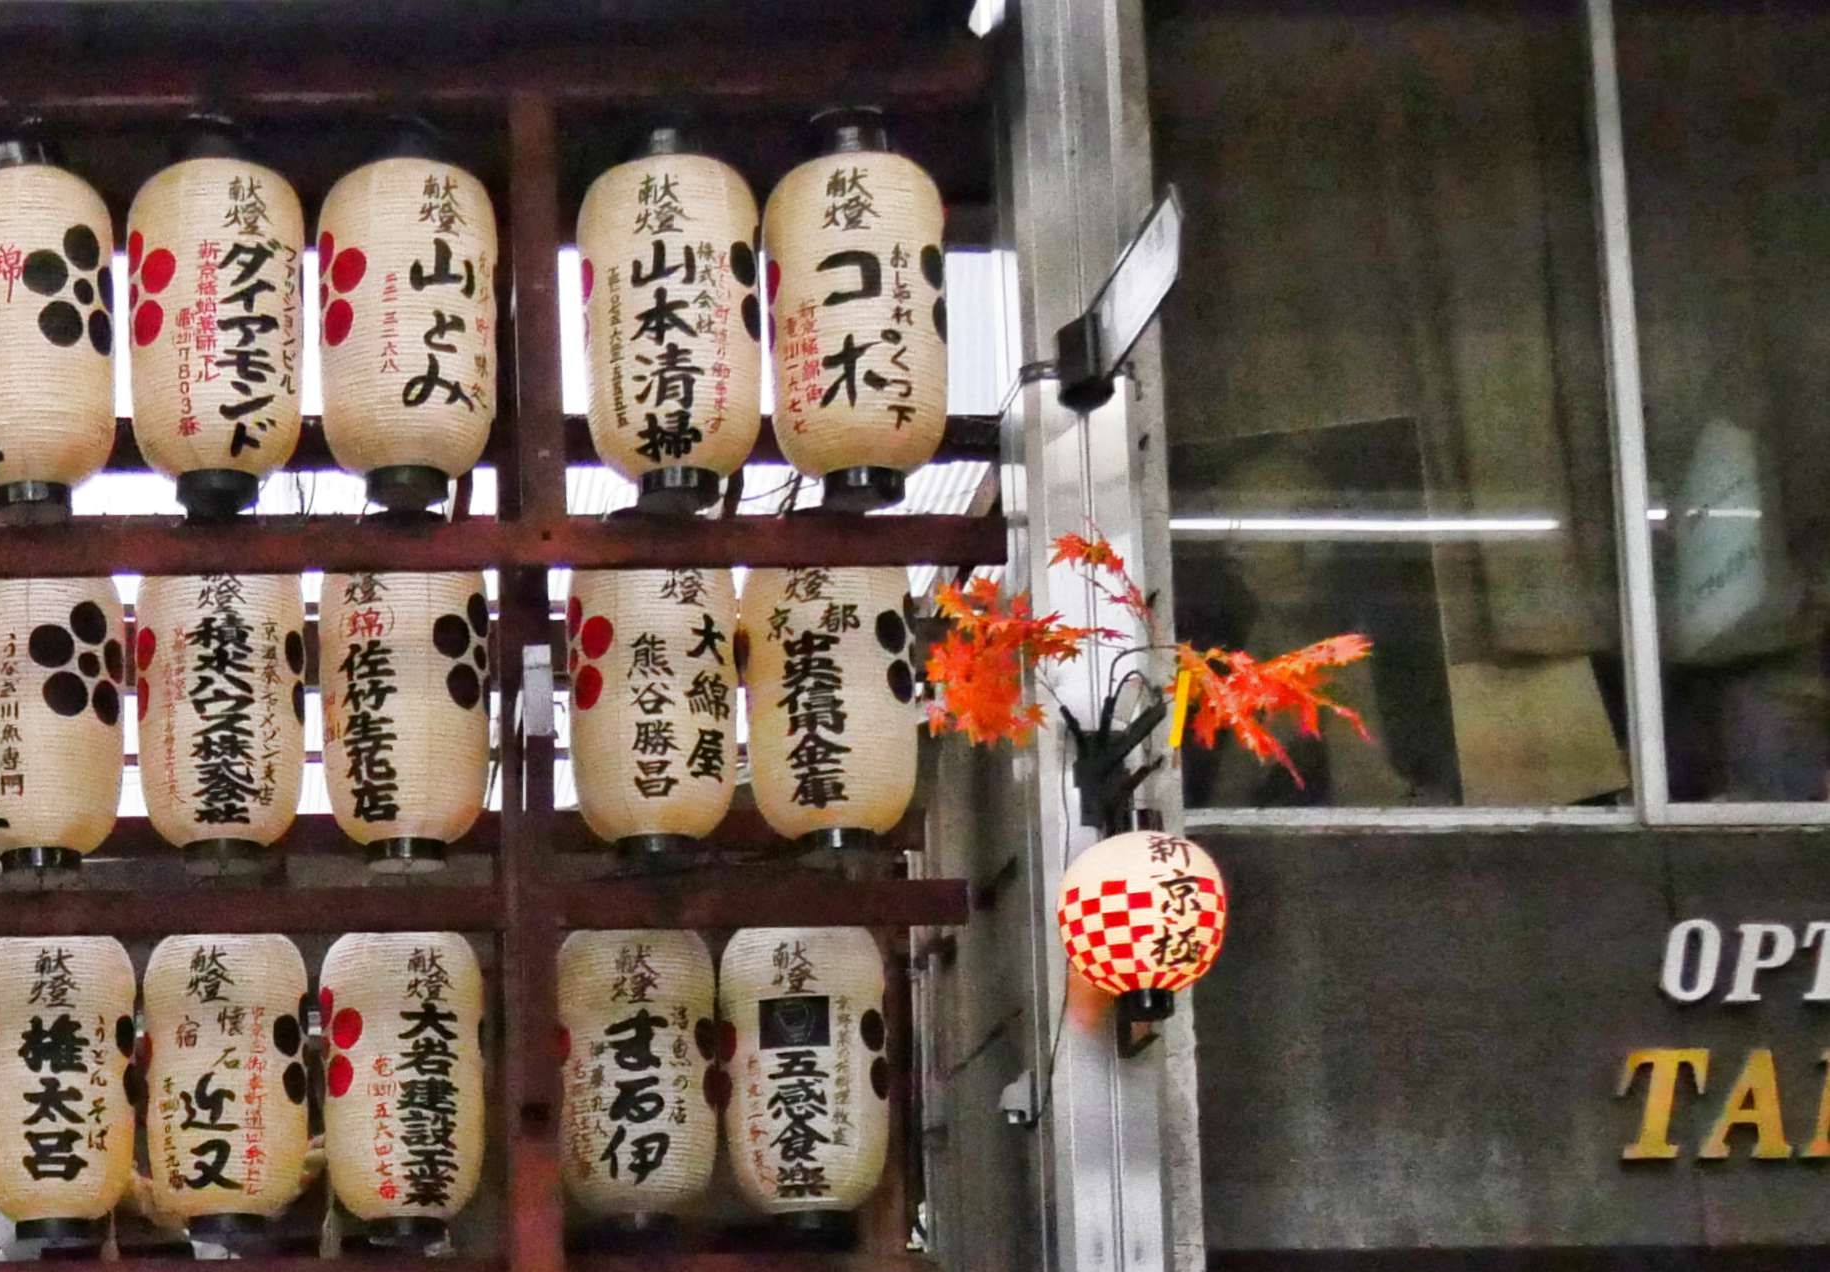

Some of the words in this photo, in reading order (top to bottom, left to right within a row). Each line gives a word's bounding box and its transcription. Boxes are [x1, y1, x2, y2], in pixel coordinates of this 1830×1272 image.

[214, 238, 282, 457] ダイアモンド
[401, 238, 476, 412] 山とみ
[630, 240, 704, 463] 山本清掃
[1146, 834, 1203, 967] 新京極
